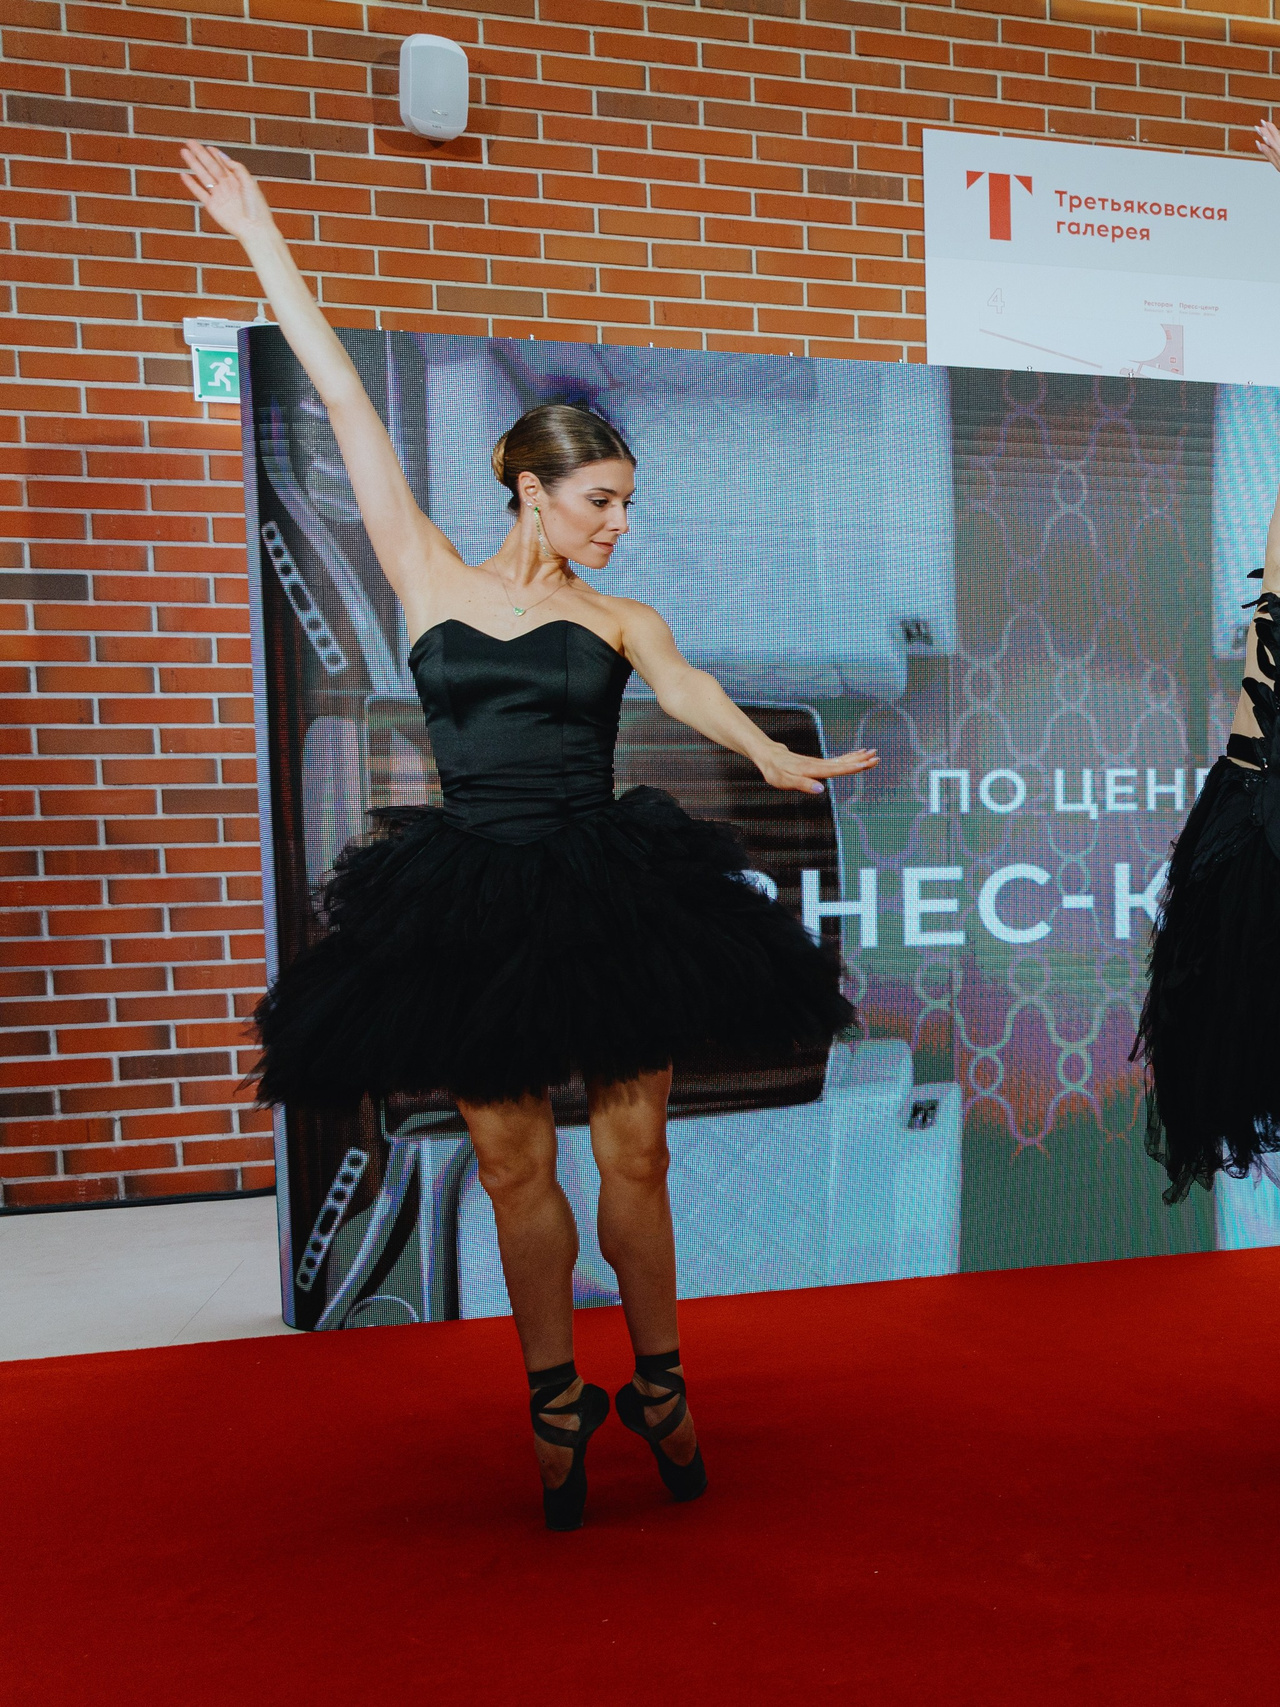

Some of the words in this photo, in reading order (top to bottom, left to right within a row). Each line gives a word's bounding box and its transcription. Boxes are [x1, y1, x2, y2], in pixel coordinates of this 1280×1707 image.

[1054, 189, 1229, 221] Третьяковская
[1055, 219, 1151, 243] галерея
[987, 288, 1005, 314] 4
[928, 768, 1027, 814] ПО
